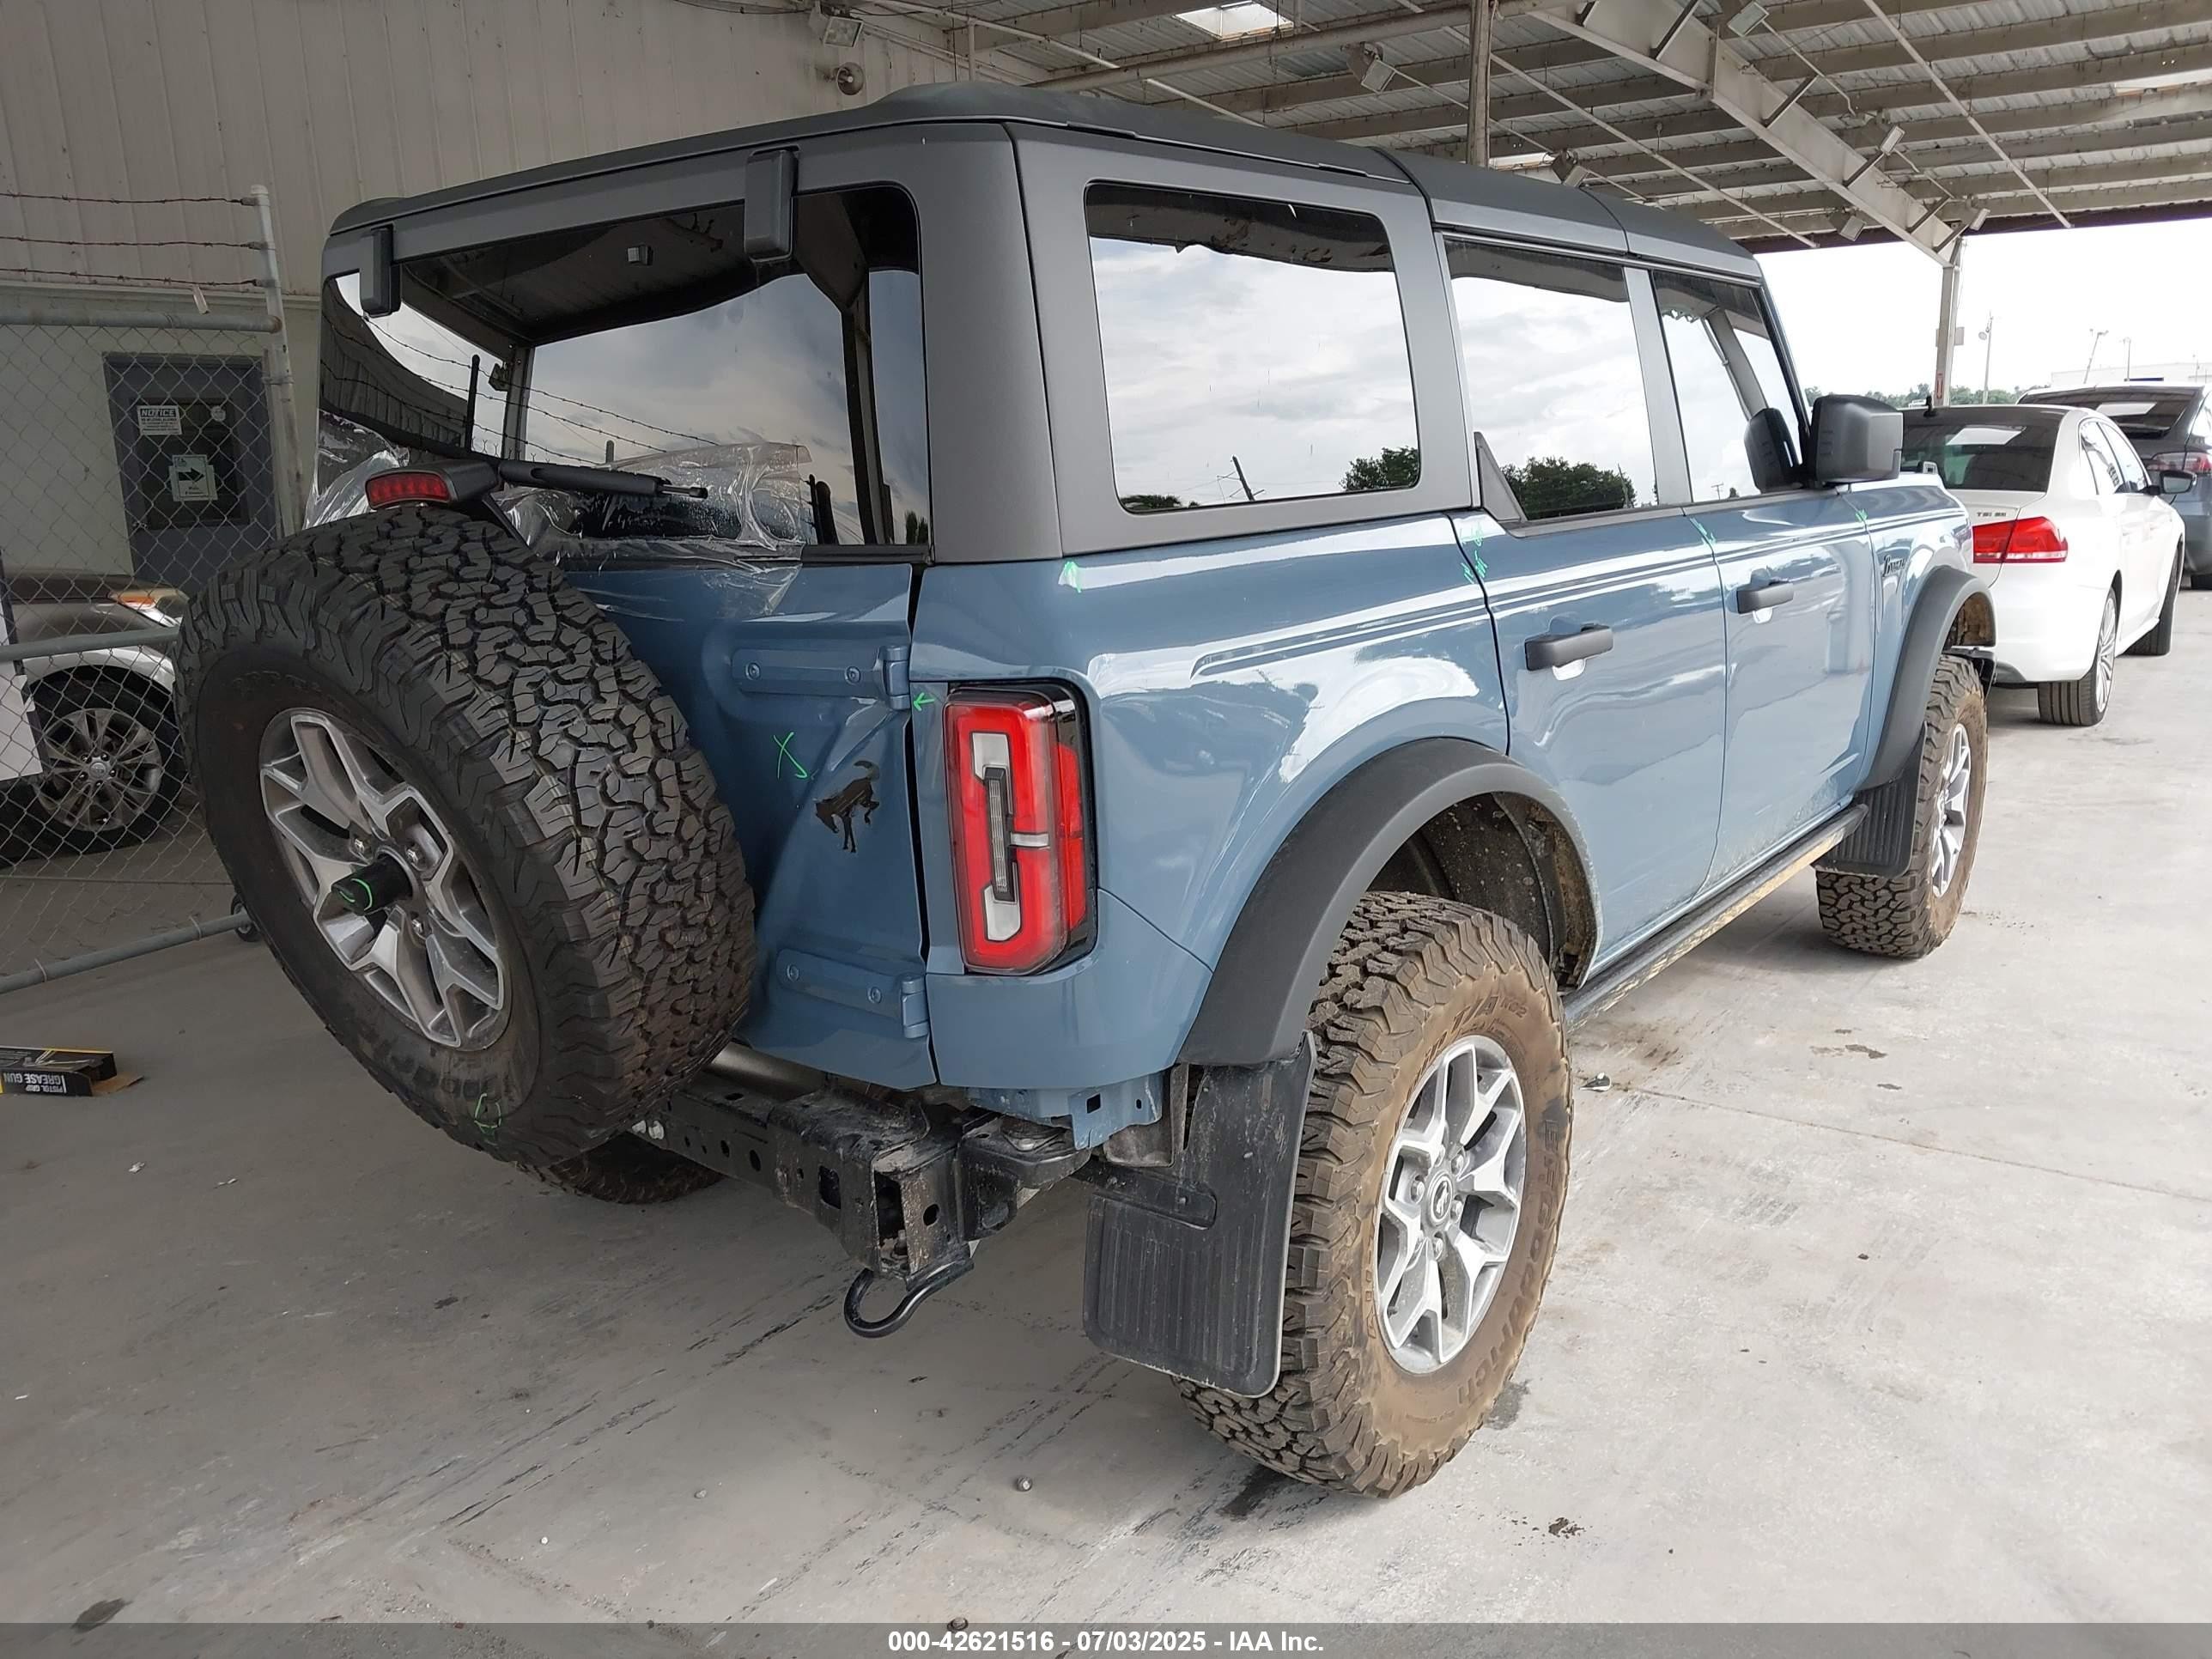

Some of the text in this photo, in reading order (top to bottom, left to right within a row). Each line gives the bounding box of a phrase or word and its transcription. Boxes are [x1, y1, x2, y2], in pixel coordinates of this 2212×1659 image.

[4, 1073, 61, 1085] GREASE GUN
[26, 1084, 64, 1093] PISTOL GRIP
